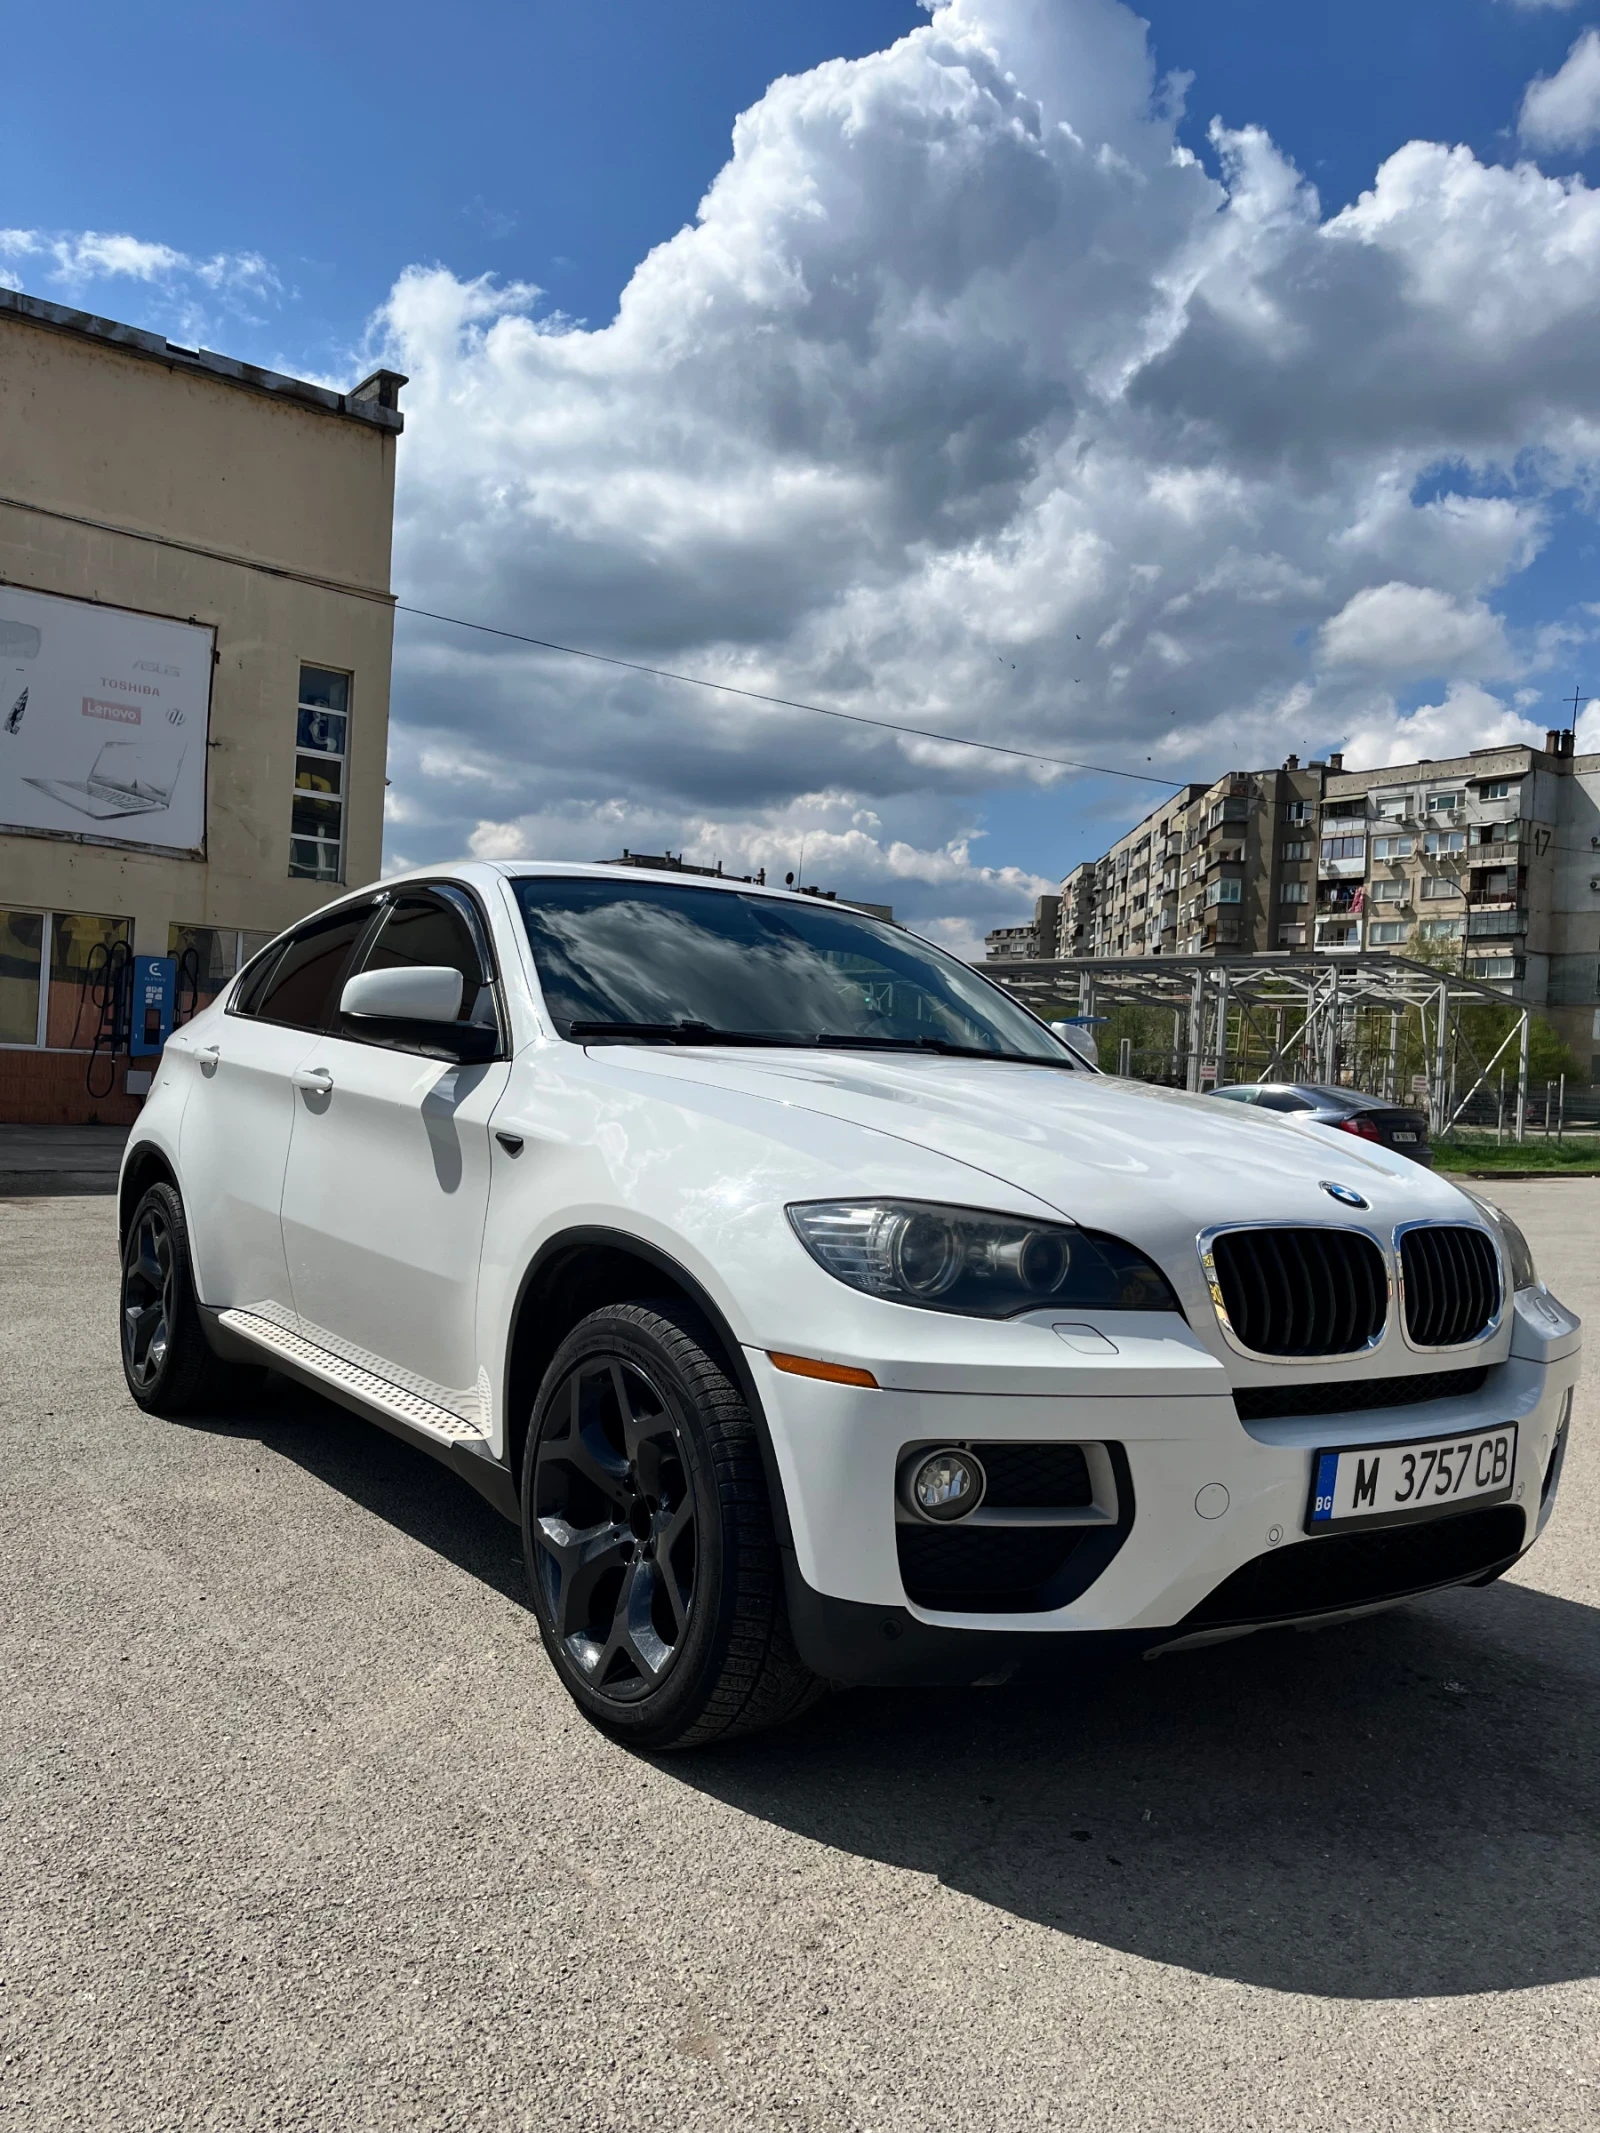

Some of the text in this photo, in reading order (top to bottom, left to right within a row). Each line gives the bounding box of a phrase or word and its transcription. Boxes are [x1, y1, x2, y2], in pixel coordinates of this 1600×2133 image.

[131, 660, 181, 677] ASUS
[100, 677, 161, 697] TOSHIBA
[1534, 829, 1552, 857] 17
[1352, 1437, 1508, 1509] M 3757 CB
[1315, 1496, 1332, 1512] BG
